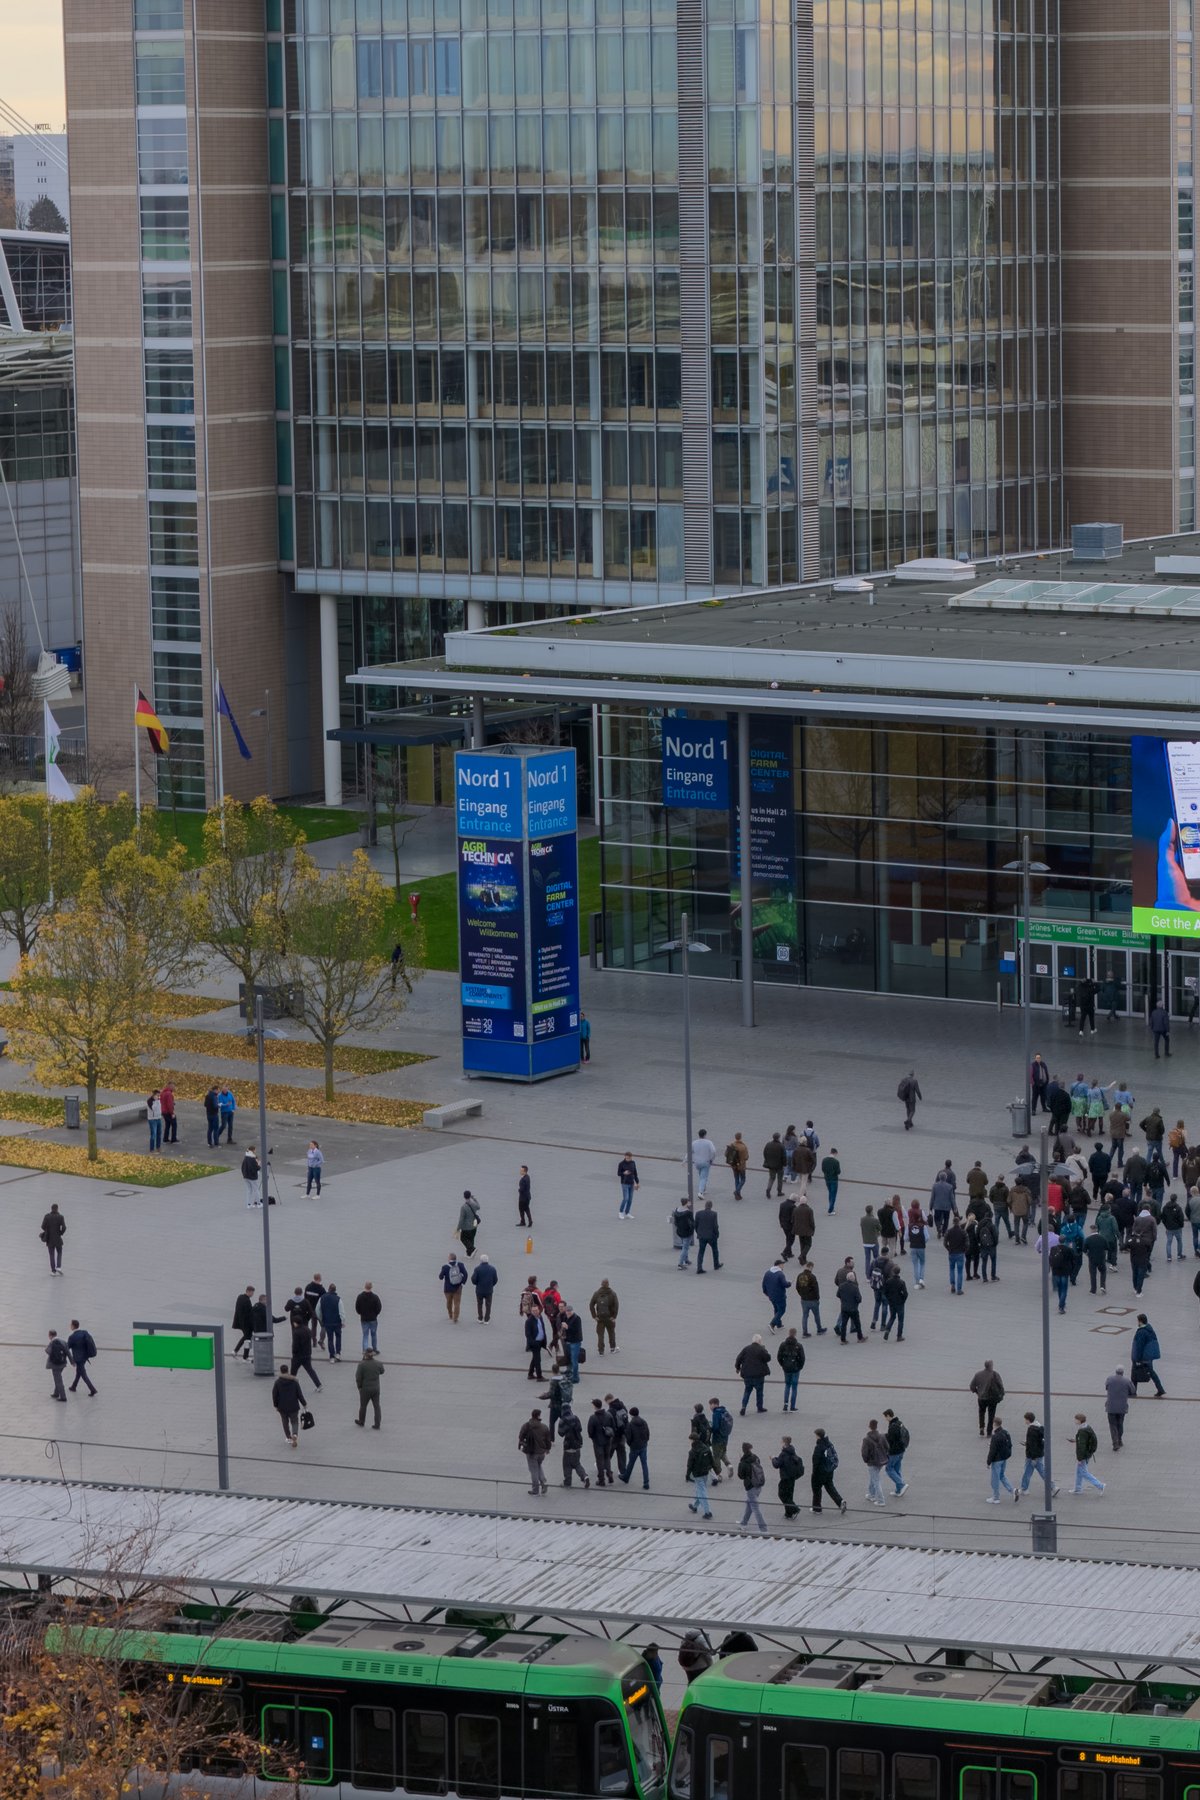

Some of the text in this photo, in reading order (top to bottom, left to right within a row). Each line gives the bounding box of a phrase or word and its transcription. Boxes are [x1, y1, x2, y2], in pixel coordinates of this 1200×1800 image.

[666, 736, 728, 760] Nord 1
[750, 750, 786, 760] DIGITAL
[750, 759, 778, 768] FARM
[458, 768, 510, 788] Nord 1
[528, 765, 567, 788] Nord 1
[666, 768, 713, 787] Eingang
[750, 768, 789, 778] CENTER
[667, 786, 717, 801] Entrance
[459, 799, 508, 818] Eingang
[528, 798, 565, 816] Eingang
[766, 807, 779, 816] Hall
[460, 816, 512, 833] Entrance
[529, 816, 568, 833] Entrance
[462, 841, 486, 852] AGRI
[546, 881, 573, 894] DIGITAL
[546, 891, 566, 902] FARM
[546, 899, 574, 911] CENTER
[467, 918, 496, 928] Welcome
[1151, 915, 1171, 929] Get
[1173, 917, 1191, 930] the
[479, 928, 518, 939] Willkommen
[1052, 925, 1072, 934] Ticket
[1077, 926, 1118, 937] Green Ticket
[483, 1018, 493, 1026] 20
[168, 1673, 174, 1682] 8
[548, 1704, 569, 1712] ÜSTRA
[1079, 1752, 1140, 1765] 8 Hauptbahnhof
